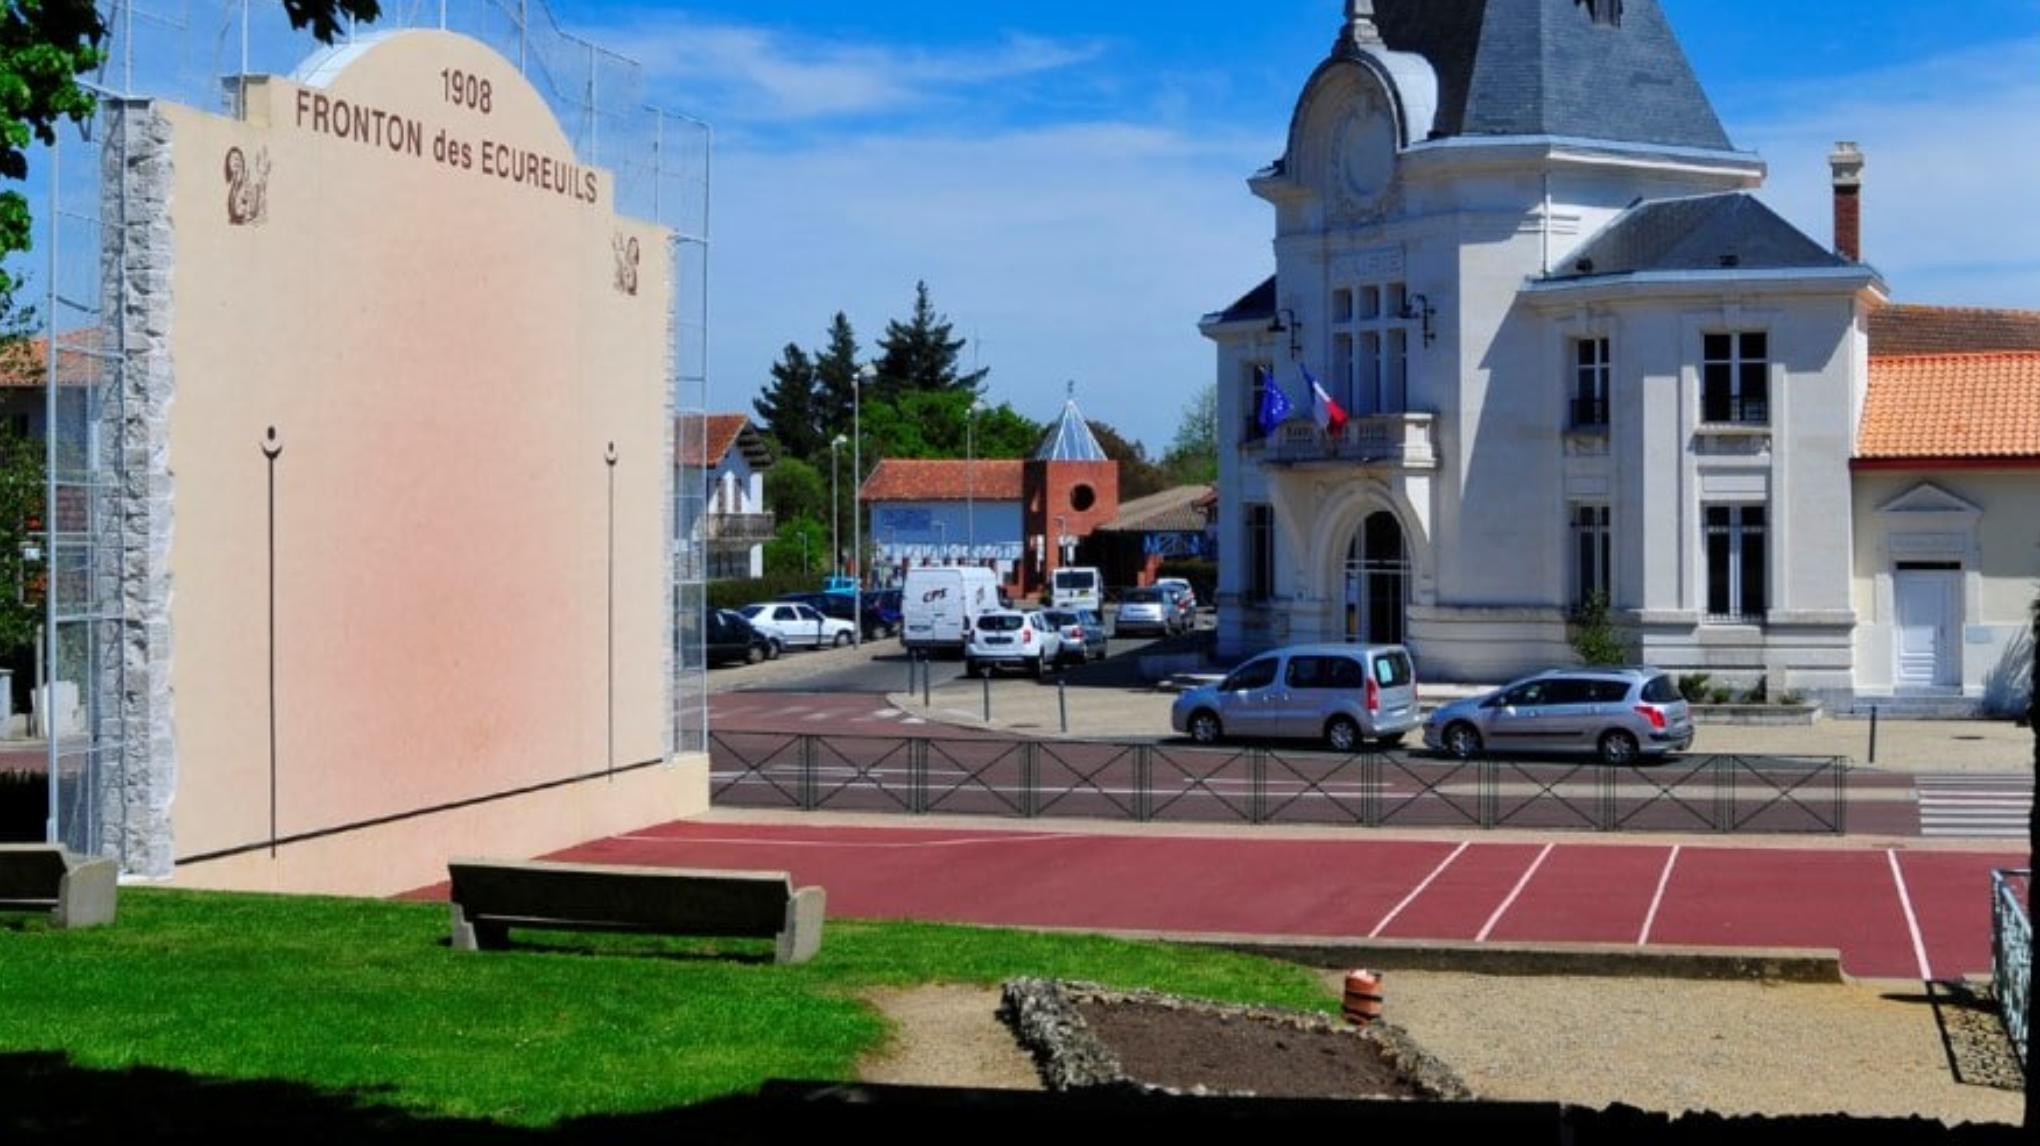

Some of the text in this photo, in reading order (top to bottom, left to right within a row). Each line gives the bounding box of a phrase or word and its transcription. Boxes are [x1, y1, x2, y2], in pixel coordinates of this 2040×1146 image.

[440, 68, 493, 115] 1908
[296, 88, 597, 203] FRONTON des ECUREUILS
